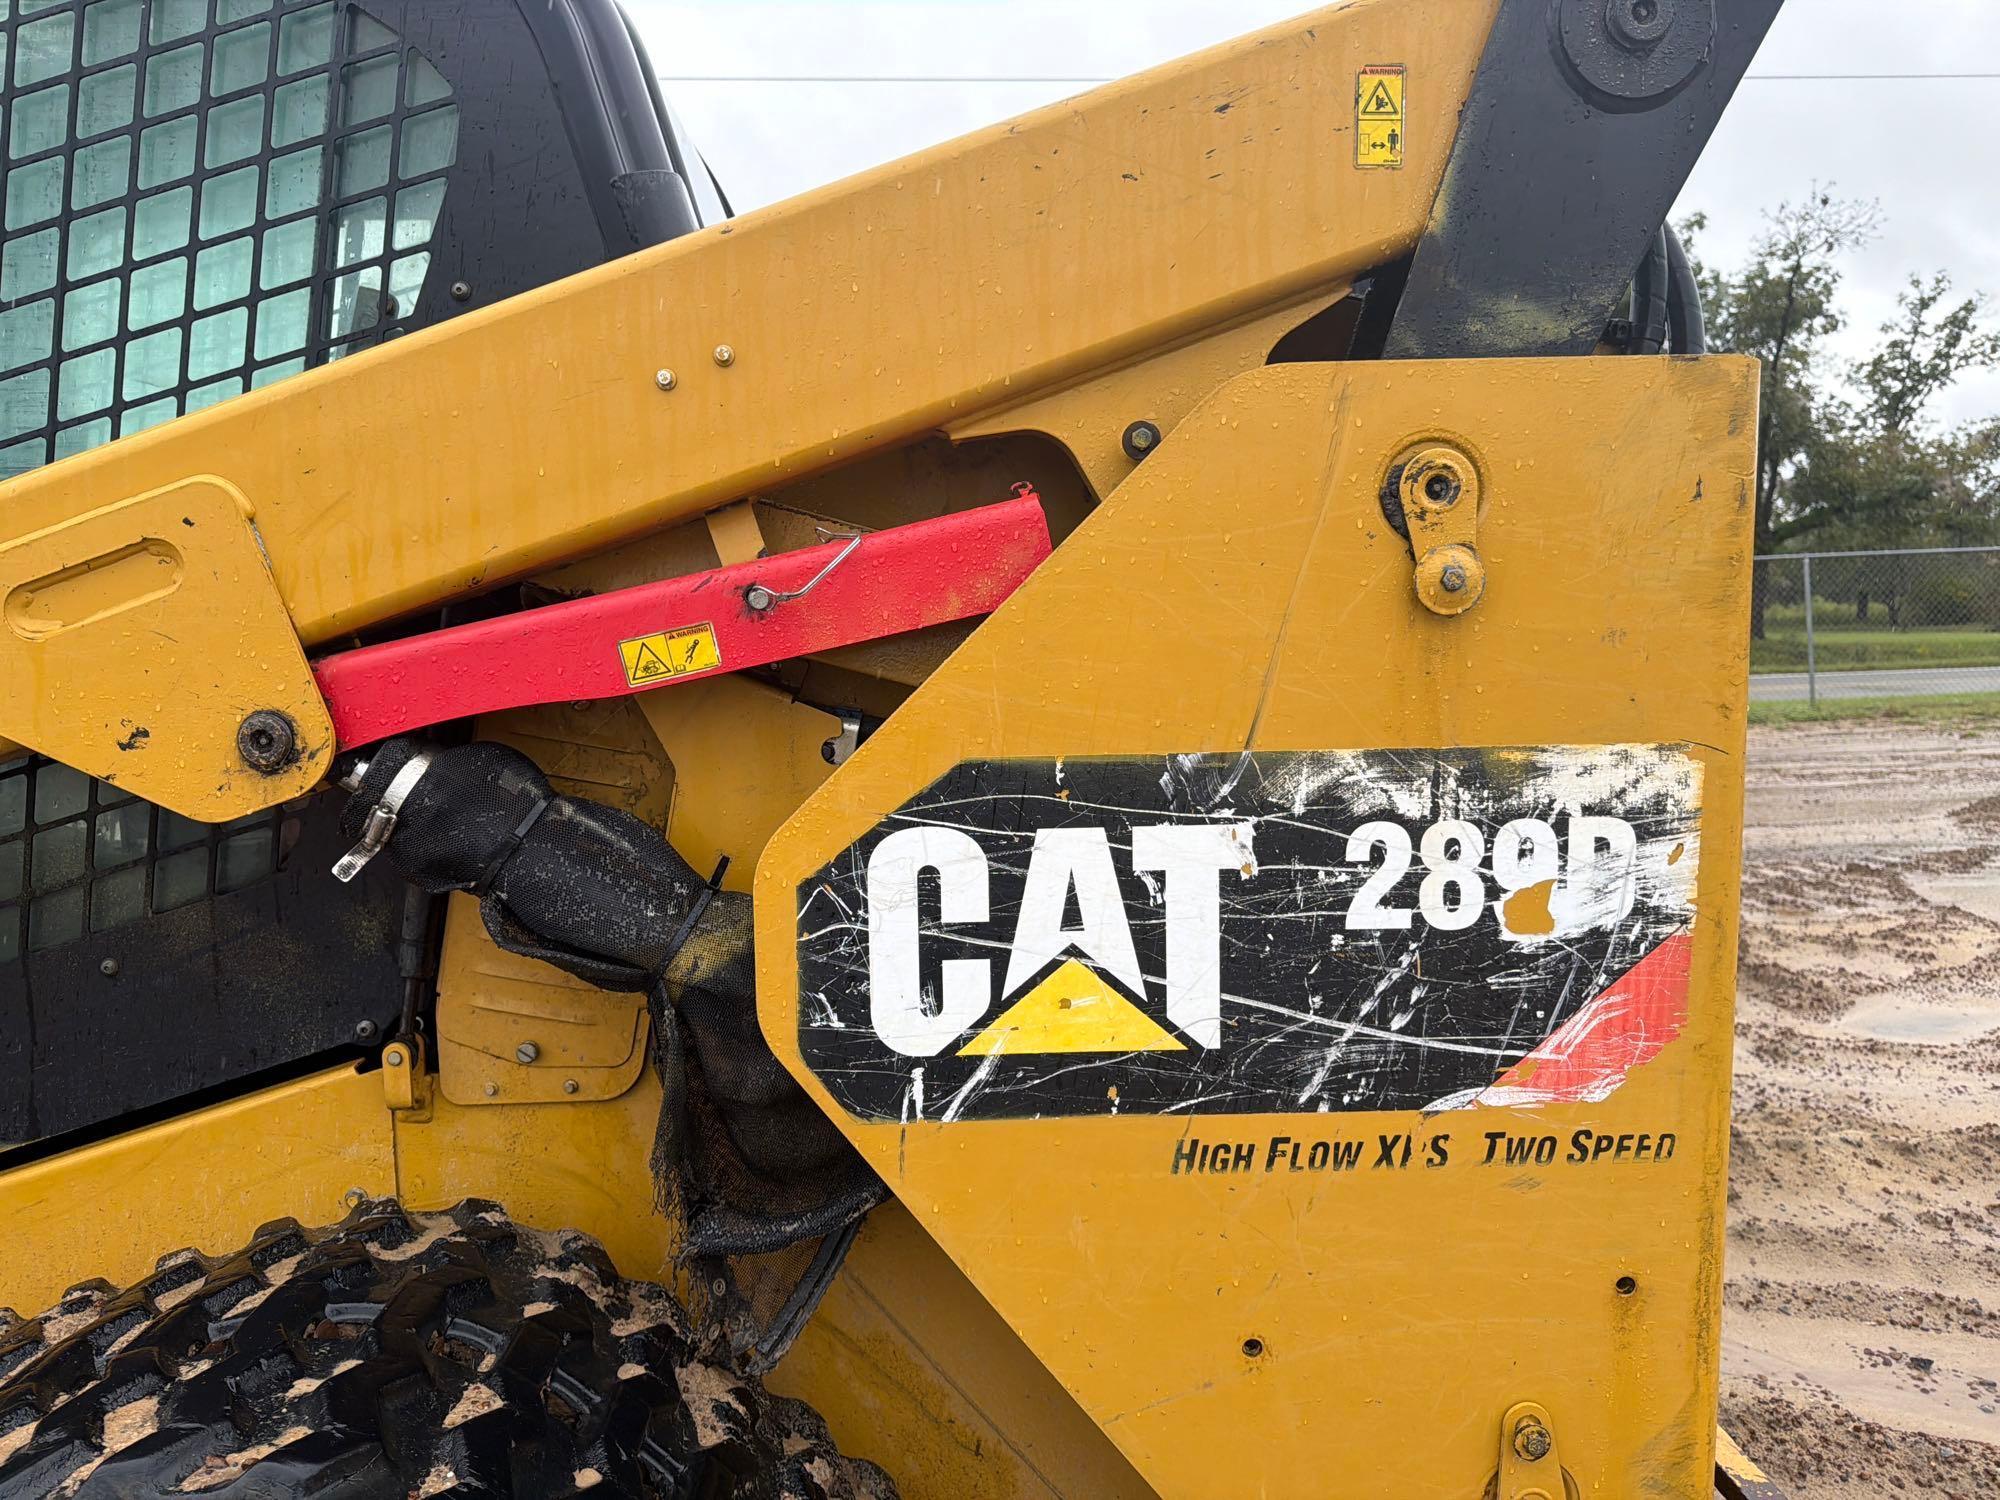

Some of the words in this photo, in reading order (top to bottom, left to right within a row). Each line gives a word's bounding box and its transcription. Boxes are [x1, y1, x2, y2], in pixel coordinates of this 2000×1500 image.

[675, 625, 709, 639] WARNING
[867, 824, 1254, 1057] CAT
[1170, 1138, 1255, 1174] HIGH
[1264, 1136, 1365, 1173] FLOW
[1481, 1131, 1558, 1166] TWO
[1566, 1129, 1676, 1165] SPEED
